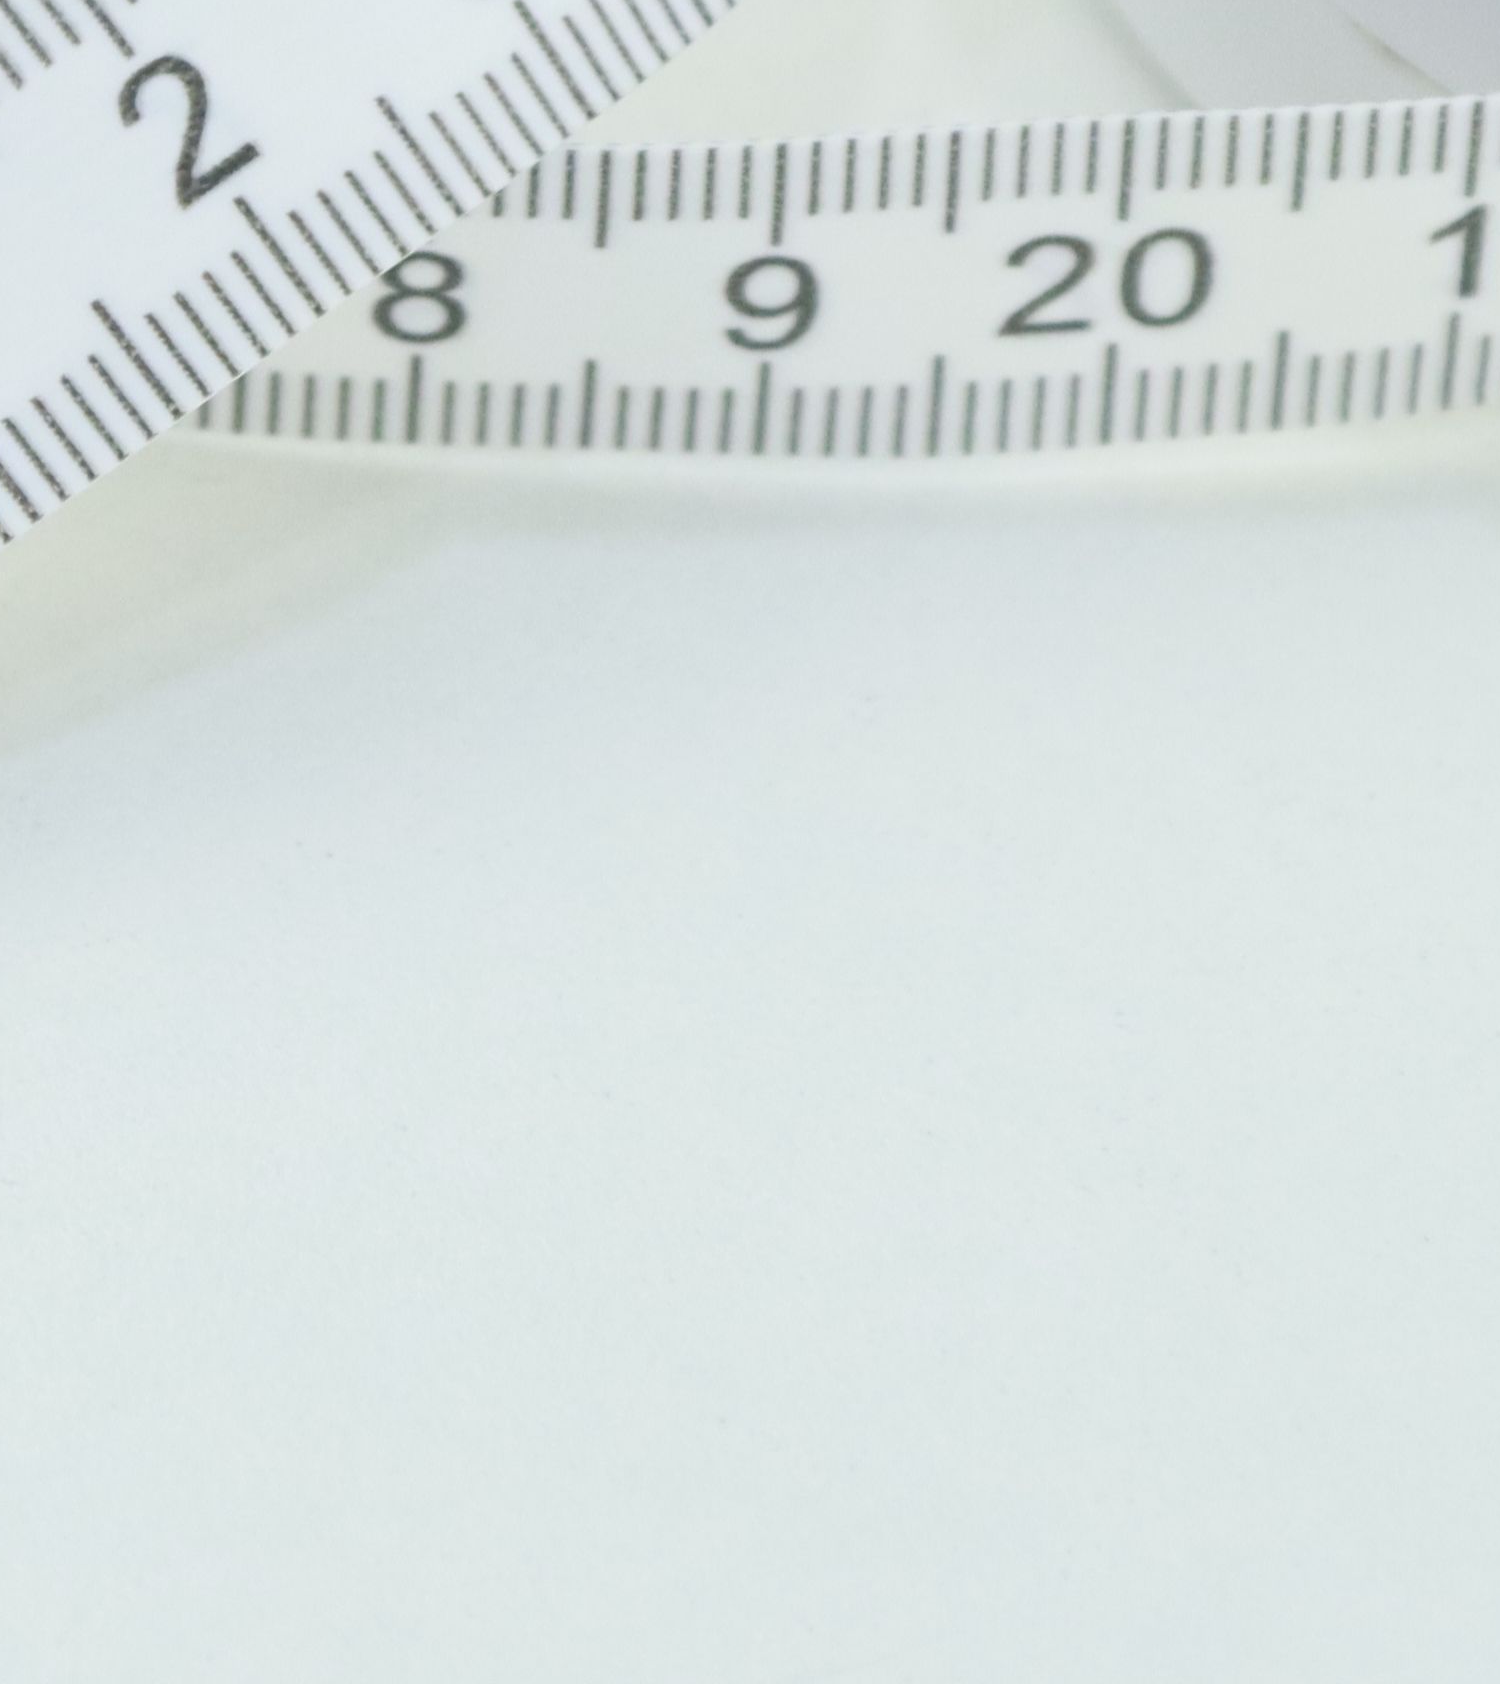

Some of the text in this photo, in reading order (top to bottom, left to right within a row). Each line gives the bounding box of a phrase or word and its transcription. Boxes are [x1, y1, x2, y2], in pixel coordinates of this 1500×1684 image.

[118, 55, 260, 209] 2
[371, 204, 1488, 352] 8 9 20 1
